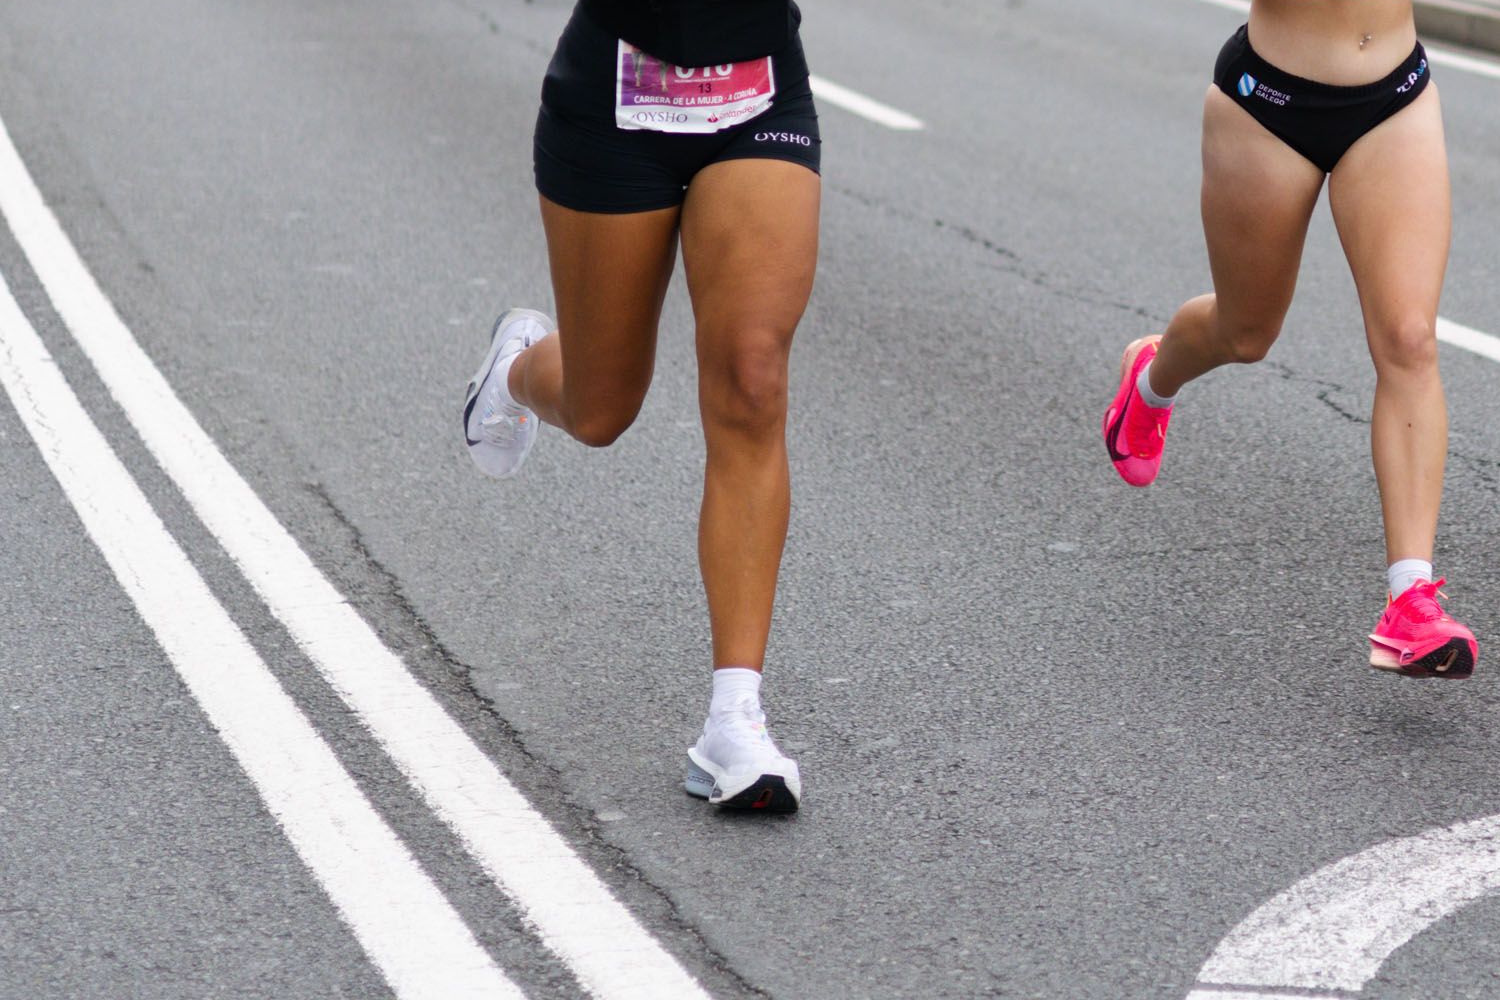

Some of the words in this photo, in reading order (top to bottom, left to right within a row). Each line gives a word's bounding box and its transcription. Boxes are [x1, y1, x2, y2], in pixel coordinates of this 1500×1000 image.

[698, 83, 712, 94] 13
[1258, 83, 1292, 102] DEPORTE
[634, 95, 671, 105] CARRERA
[672, 96, 684, 105] DE
[685, 95, 695, 105] LA
[697, 95, 723, 104] MUJER
[1255, 89, 1286, 107] GALEGO
[636, 111, 688, 123] OYSHO
[754, 132, 811, 147] OYSHO
